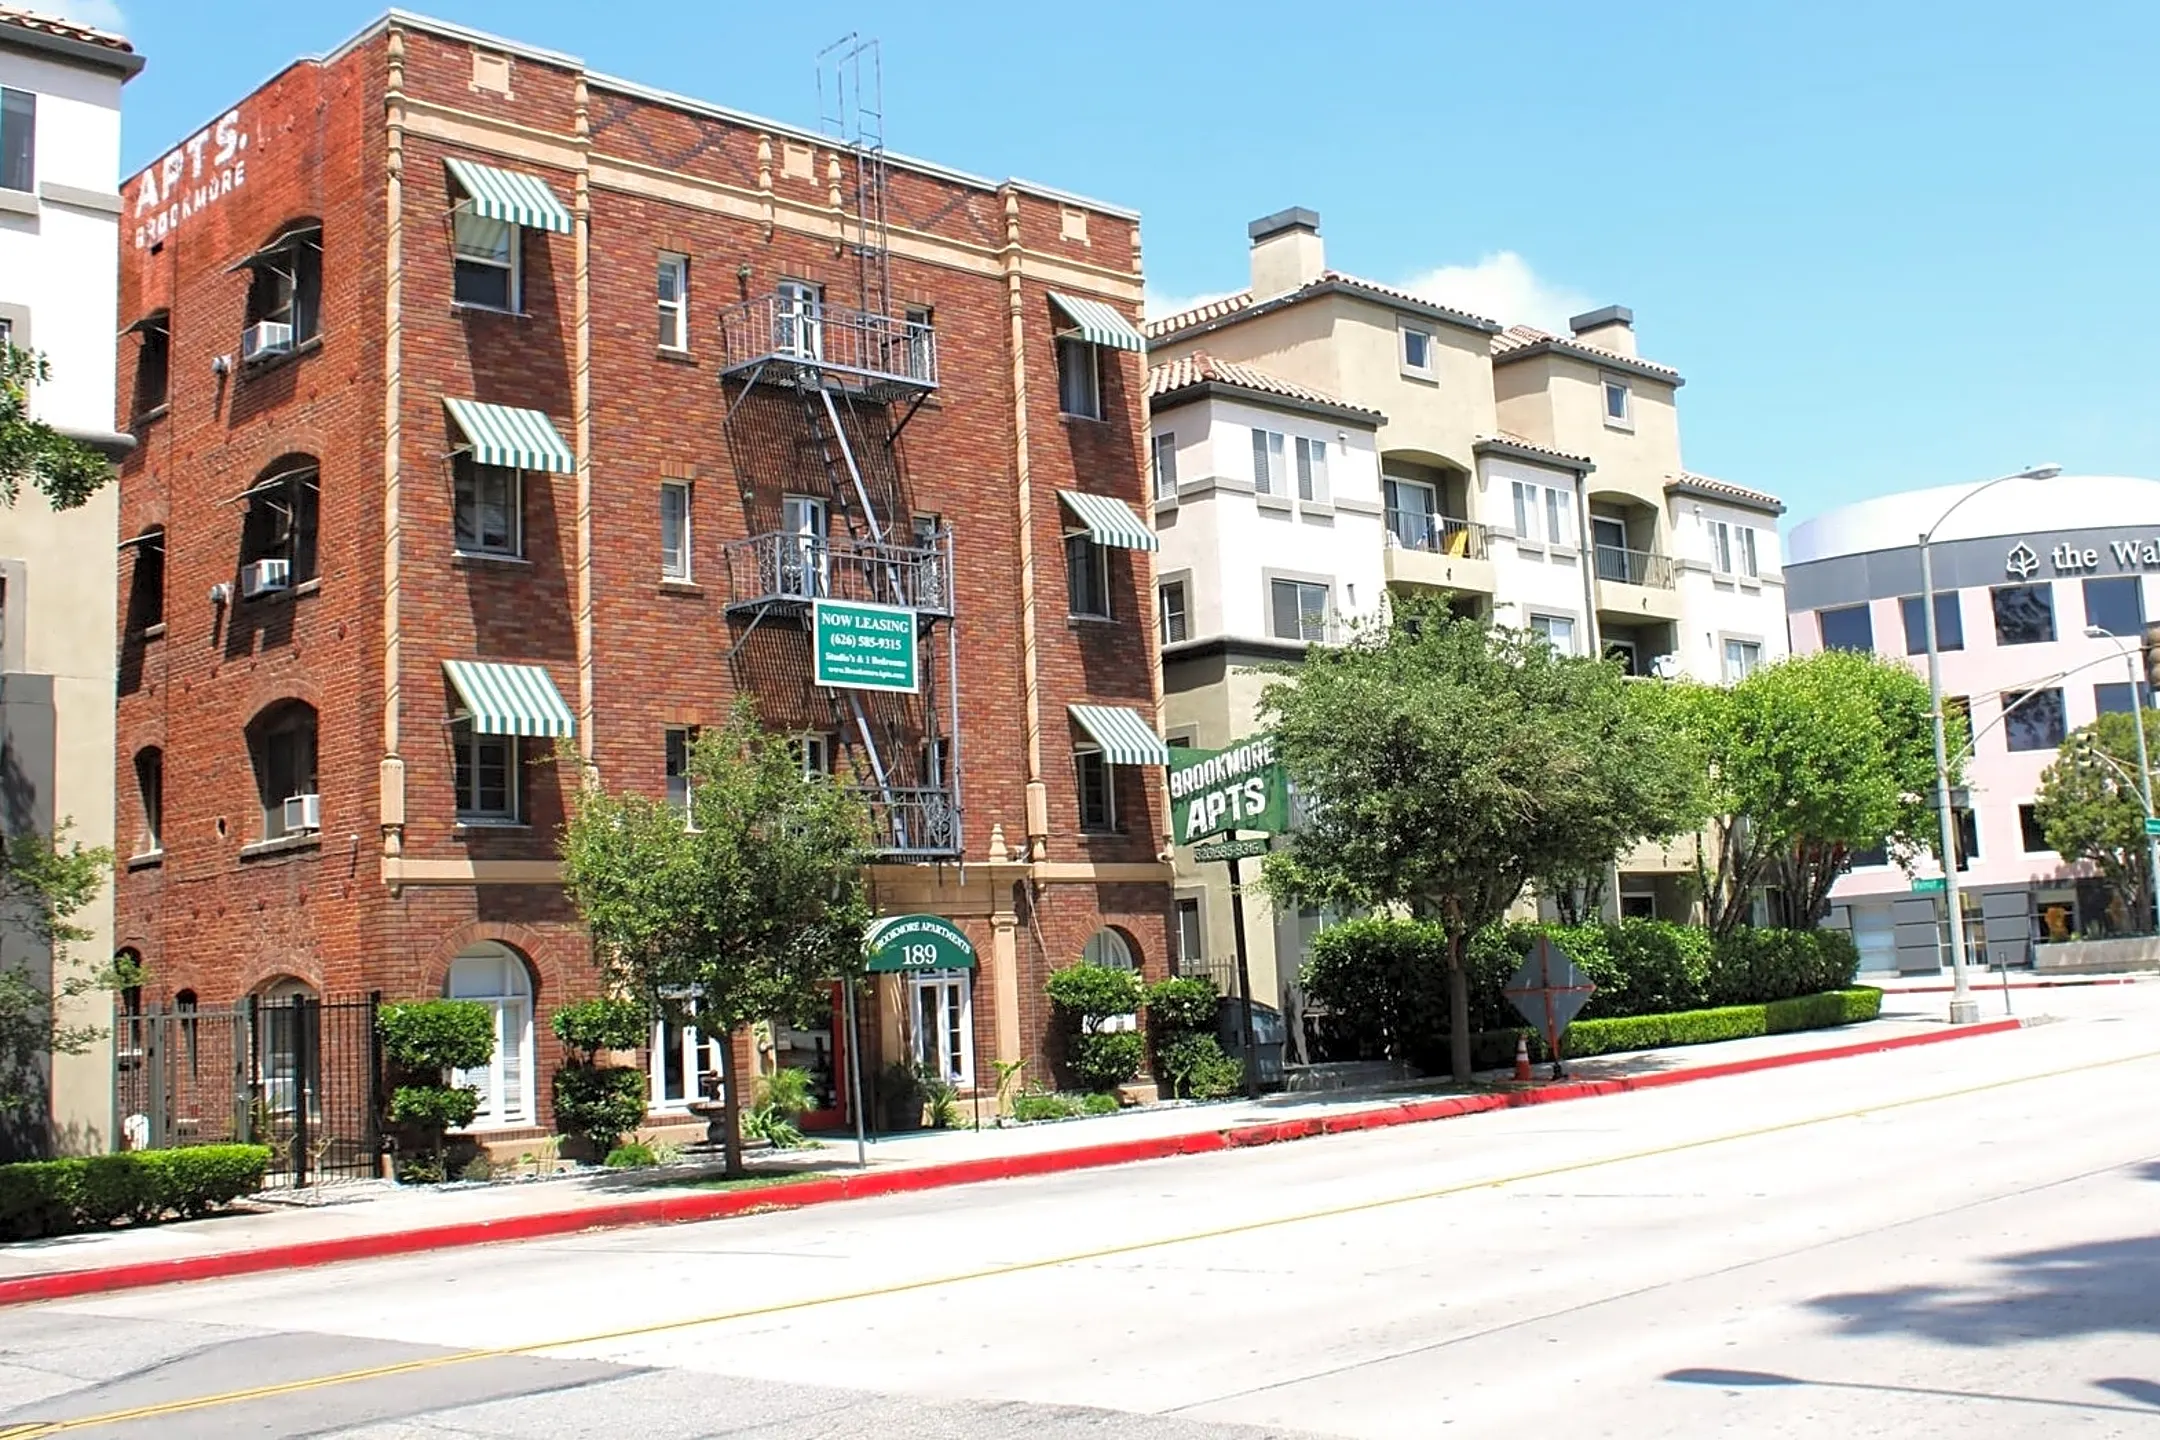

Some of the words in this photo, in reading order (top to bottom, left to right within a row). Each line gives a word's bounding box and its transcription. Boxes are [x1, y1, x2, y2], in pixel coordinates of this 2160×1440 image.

[134, 109, 248, 220] APTS.
[2052, 542, 2099, 569] the
[821, 612, 852, 627] NOW
[855, 616, 909, 633] LEASING
[830, 633, 856, 648] (626)
[858, 635, 902, 650] 585-9315
[1170, 735, 1275, 798] BROOKMORE
[1185, 777, 1266, 839] APTS
[876, 921, 920, 951] ROOKMORE
[921, 921, 972, 955] APARTMENTS
[902, 944, 937, 965] 189
